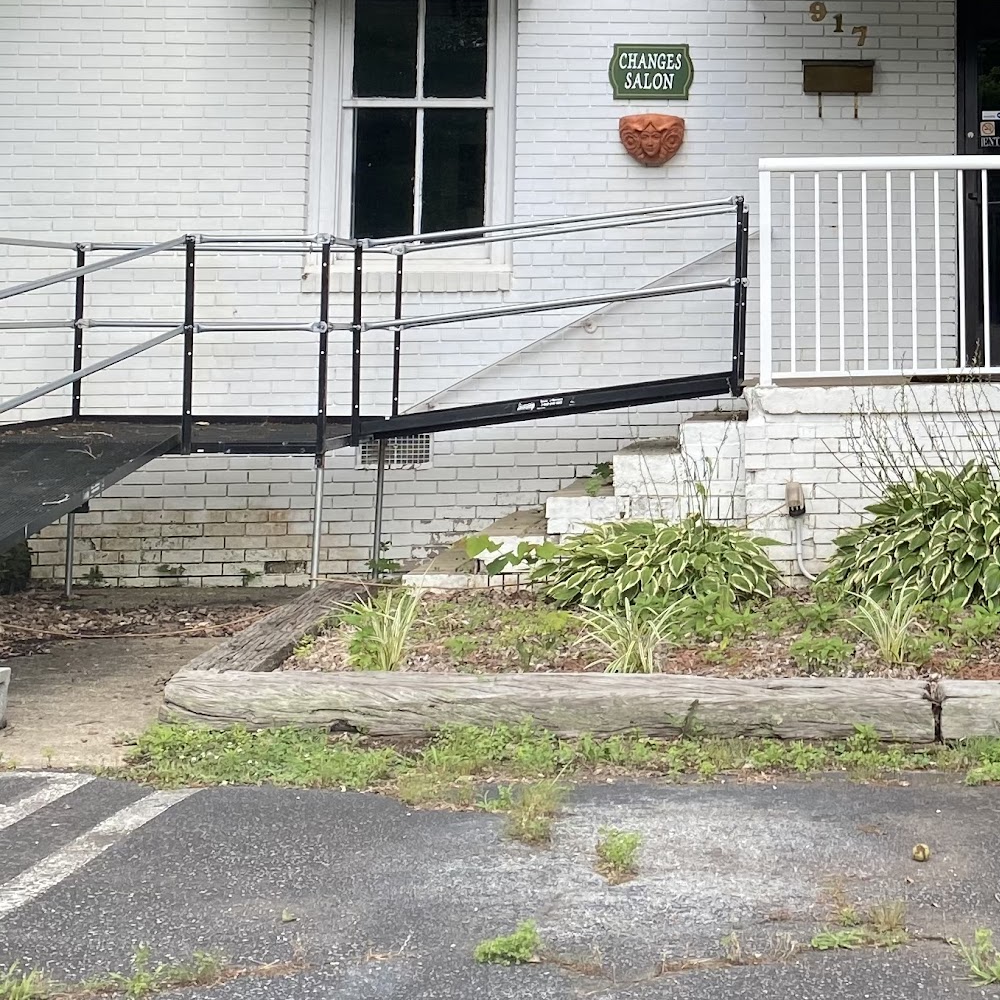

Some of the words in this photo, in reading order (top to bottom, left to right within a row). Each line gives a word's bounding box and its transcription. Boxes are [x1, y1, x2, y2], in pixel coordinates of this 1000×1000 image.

[809, 1, 868, 46] 917
[618, 52, 682, 70] CHANGES
[624, 72, 675, 90] SALON
